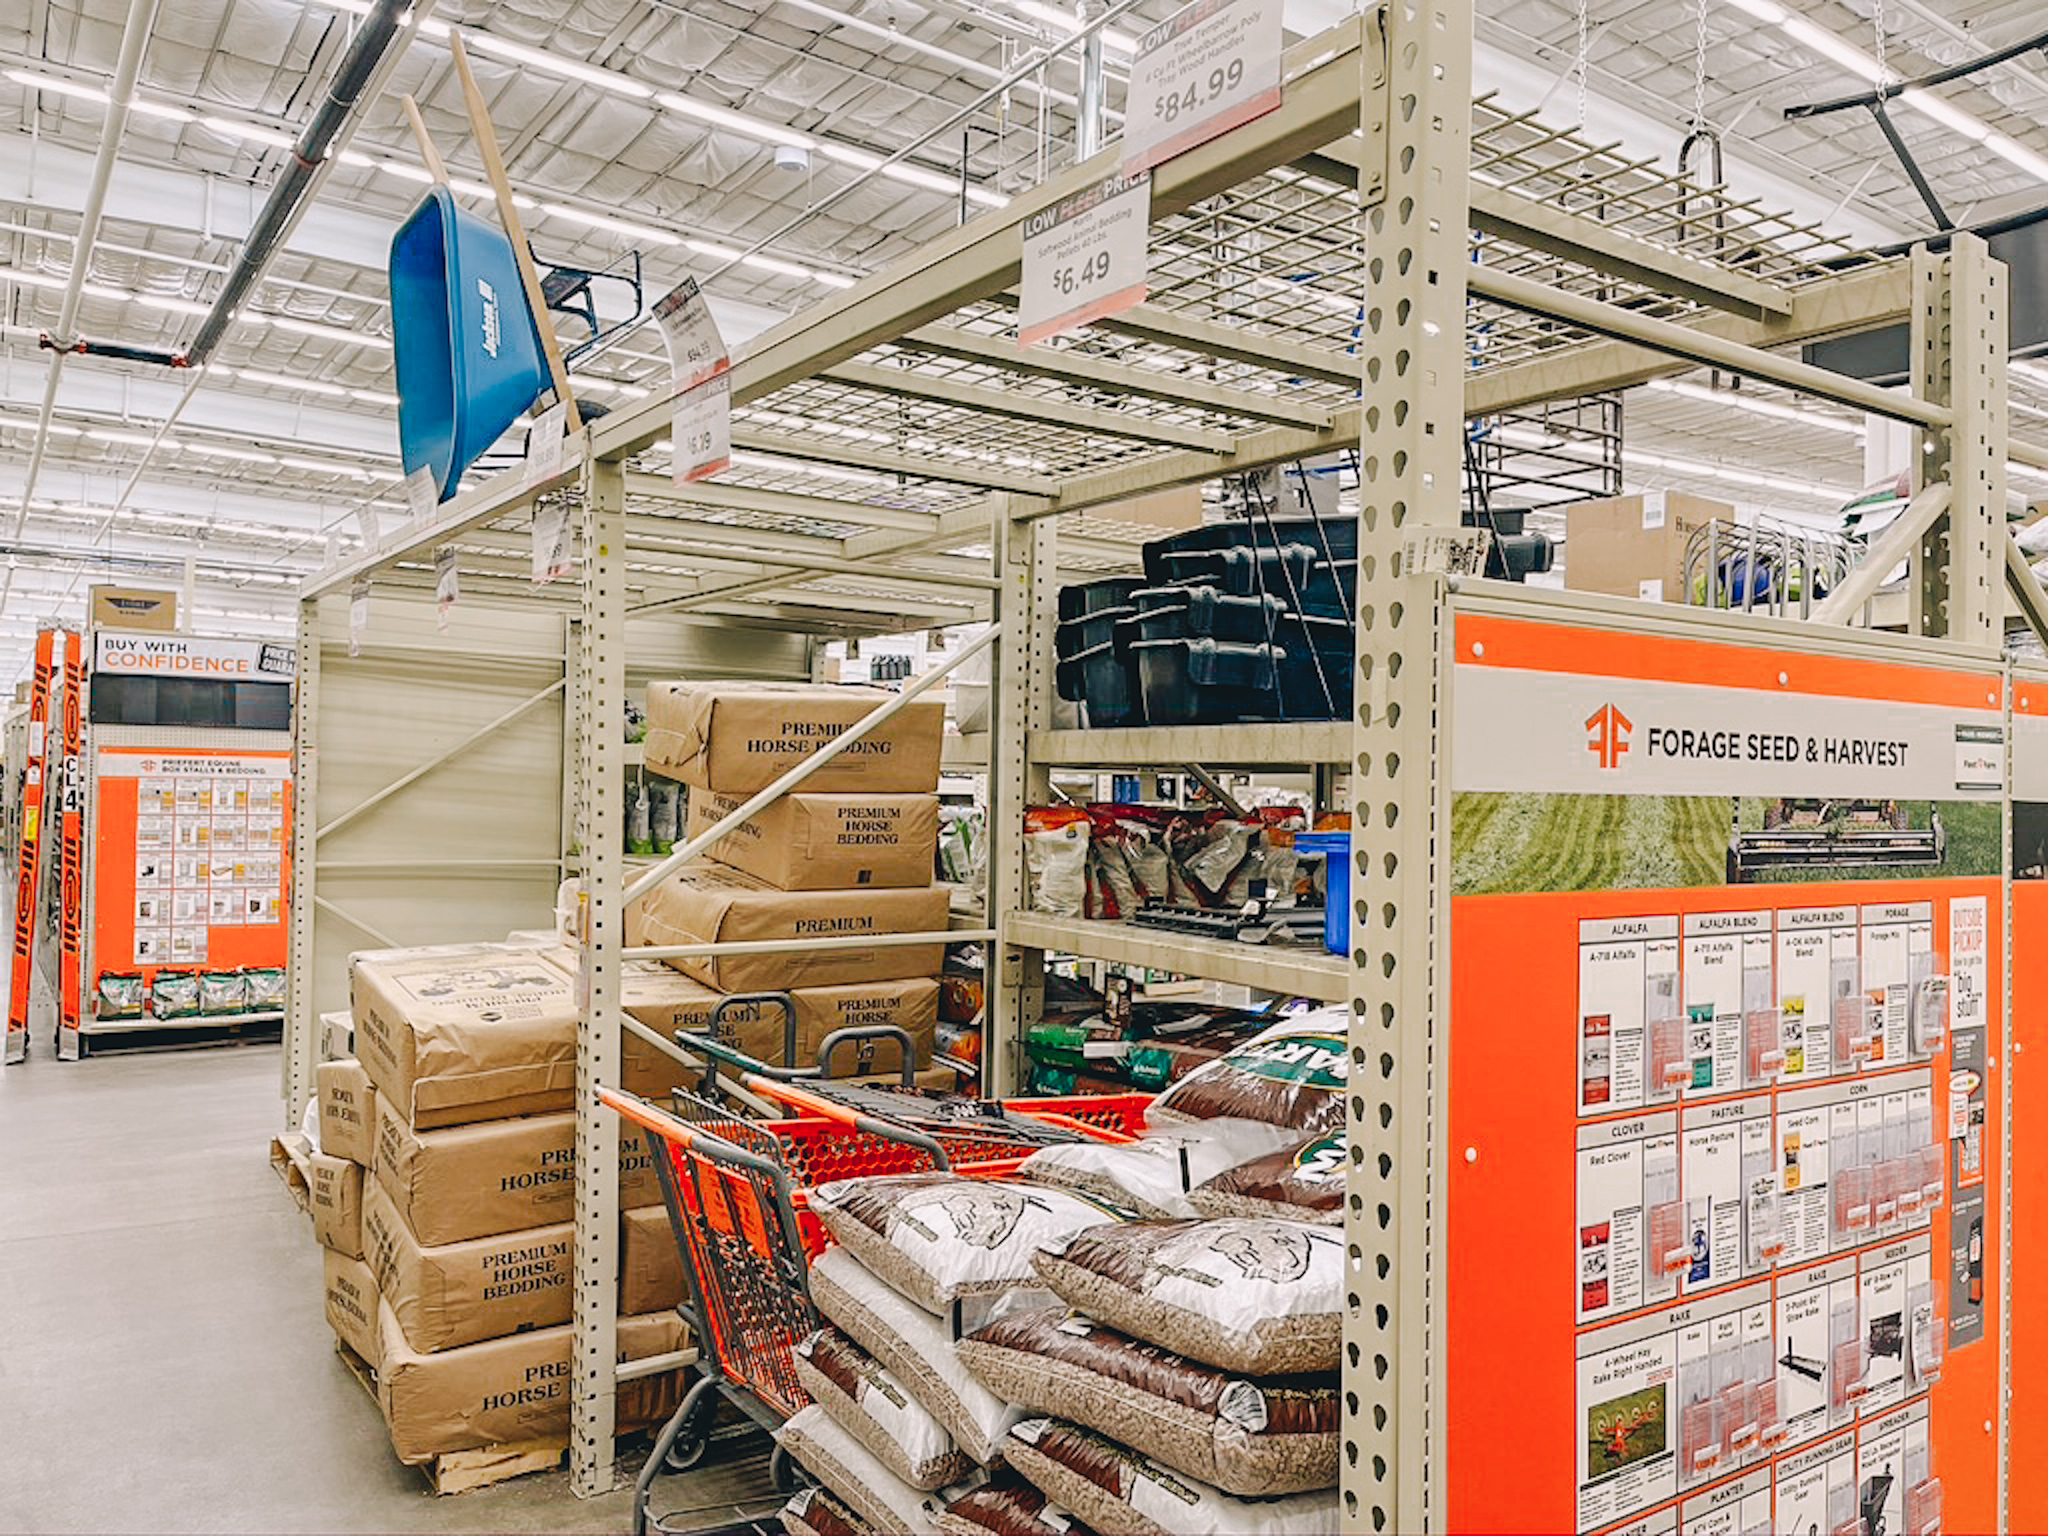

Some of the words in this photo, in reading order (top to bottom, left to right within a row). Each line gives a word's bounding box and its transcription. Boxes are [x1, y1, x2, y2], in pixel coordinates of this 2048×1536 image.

[1154, 58, 1243, 122] $84.99
[1024, 207, 1057, 238] LOW
[1053, 251, 1110, 295] $6.49
[105, 639, 138, 651] BUY
[144, 641, 187, 653] WITH
[106, 652, 249, 674] CONFIDENCE
[748, 740, 810, 753] HORSE
[1648, 728, 1740, 760] FORAGE
[1748, 735, 1800, 763] SEED
[1806, 738, 1819, 762] &
[1824, 740, 1909, 767] HARVEST
[837, 807, 901, 819] PREMIUM
[845, 821, 893, 832] HORSE
[837, 833, 899, 845] BEDDING
[796, 917, 873, 934] PREMIUM
[1699, 920, 1732, 930] ALFALFA
[1733, 918, 1758, 928] BLEND
[1791, 913, 1821, 924] ALFALFA
[1823, 912, 1844, 922] BLEND
[1611, 923, 1648, 935] ALFALFA
[1704, 955, 1723, 965] Blend
[838, 998, 901, 1012] PREMIUM
[845, 1011, 893, 1024] HORSE
[1850, 1085, 1868, 1095] CORN
[1711, 1104, 1745, 1119] PASTURE
[1611, 1122, 1645, 1137] CLOVER
[1607, 1151, 1631, 1164] Clover
[501, 1167, 576, 1192] HORSE
[482, 1241, 568, 1269] PREMIUM
[493, 1259, 557, 1283] HORSE
[483, 1272, 567, 1301] BEDDING
[1669, 1310, 1691, 1324] RAKE
[1593, 1373, 1611, 1385] Rake
[1613, 1365, 1634, 1379] Right
[1635, 1355, 1662, 1371] Handed
[483, 1382, 561, 1411] HORSE
[1710, 1482, 1744, 1503] PLANTER
